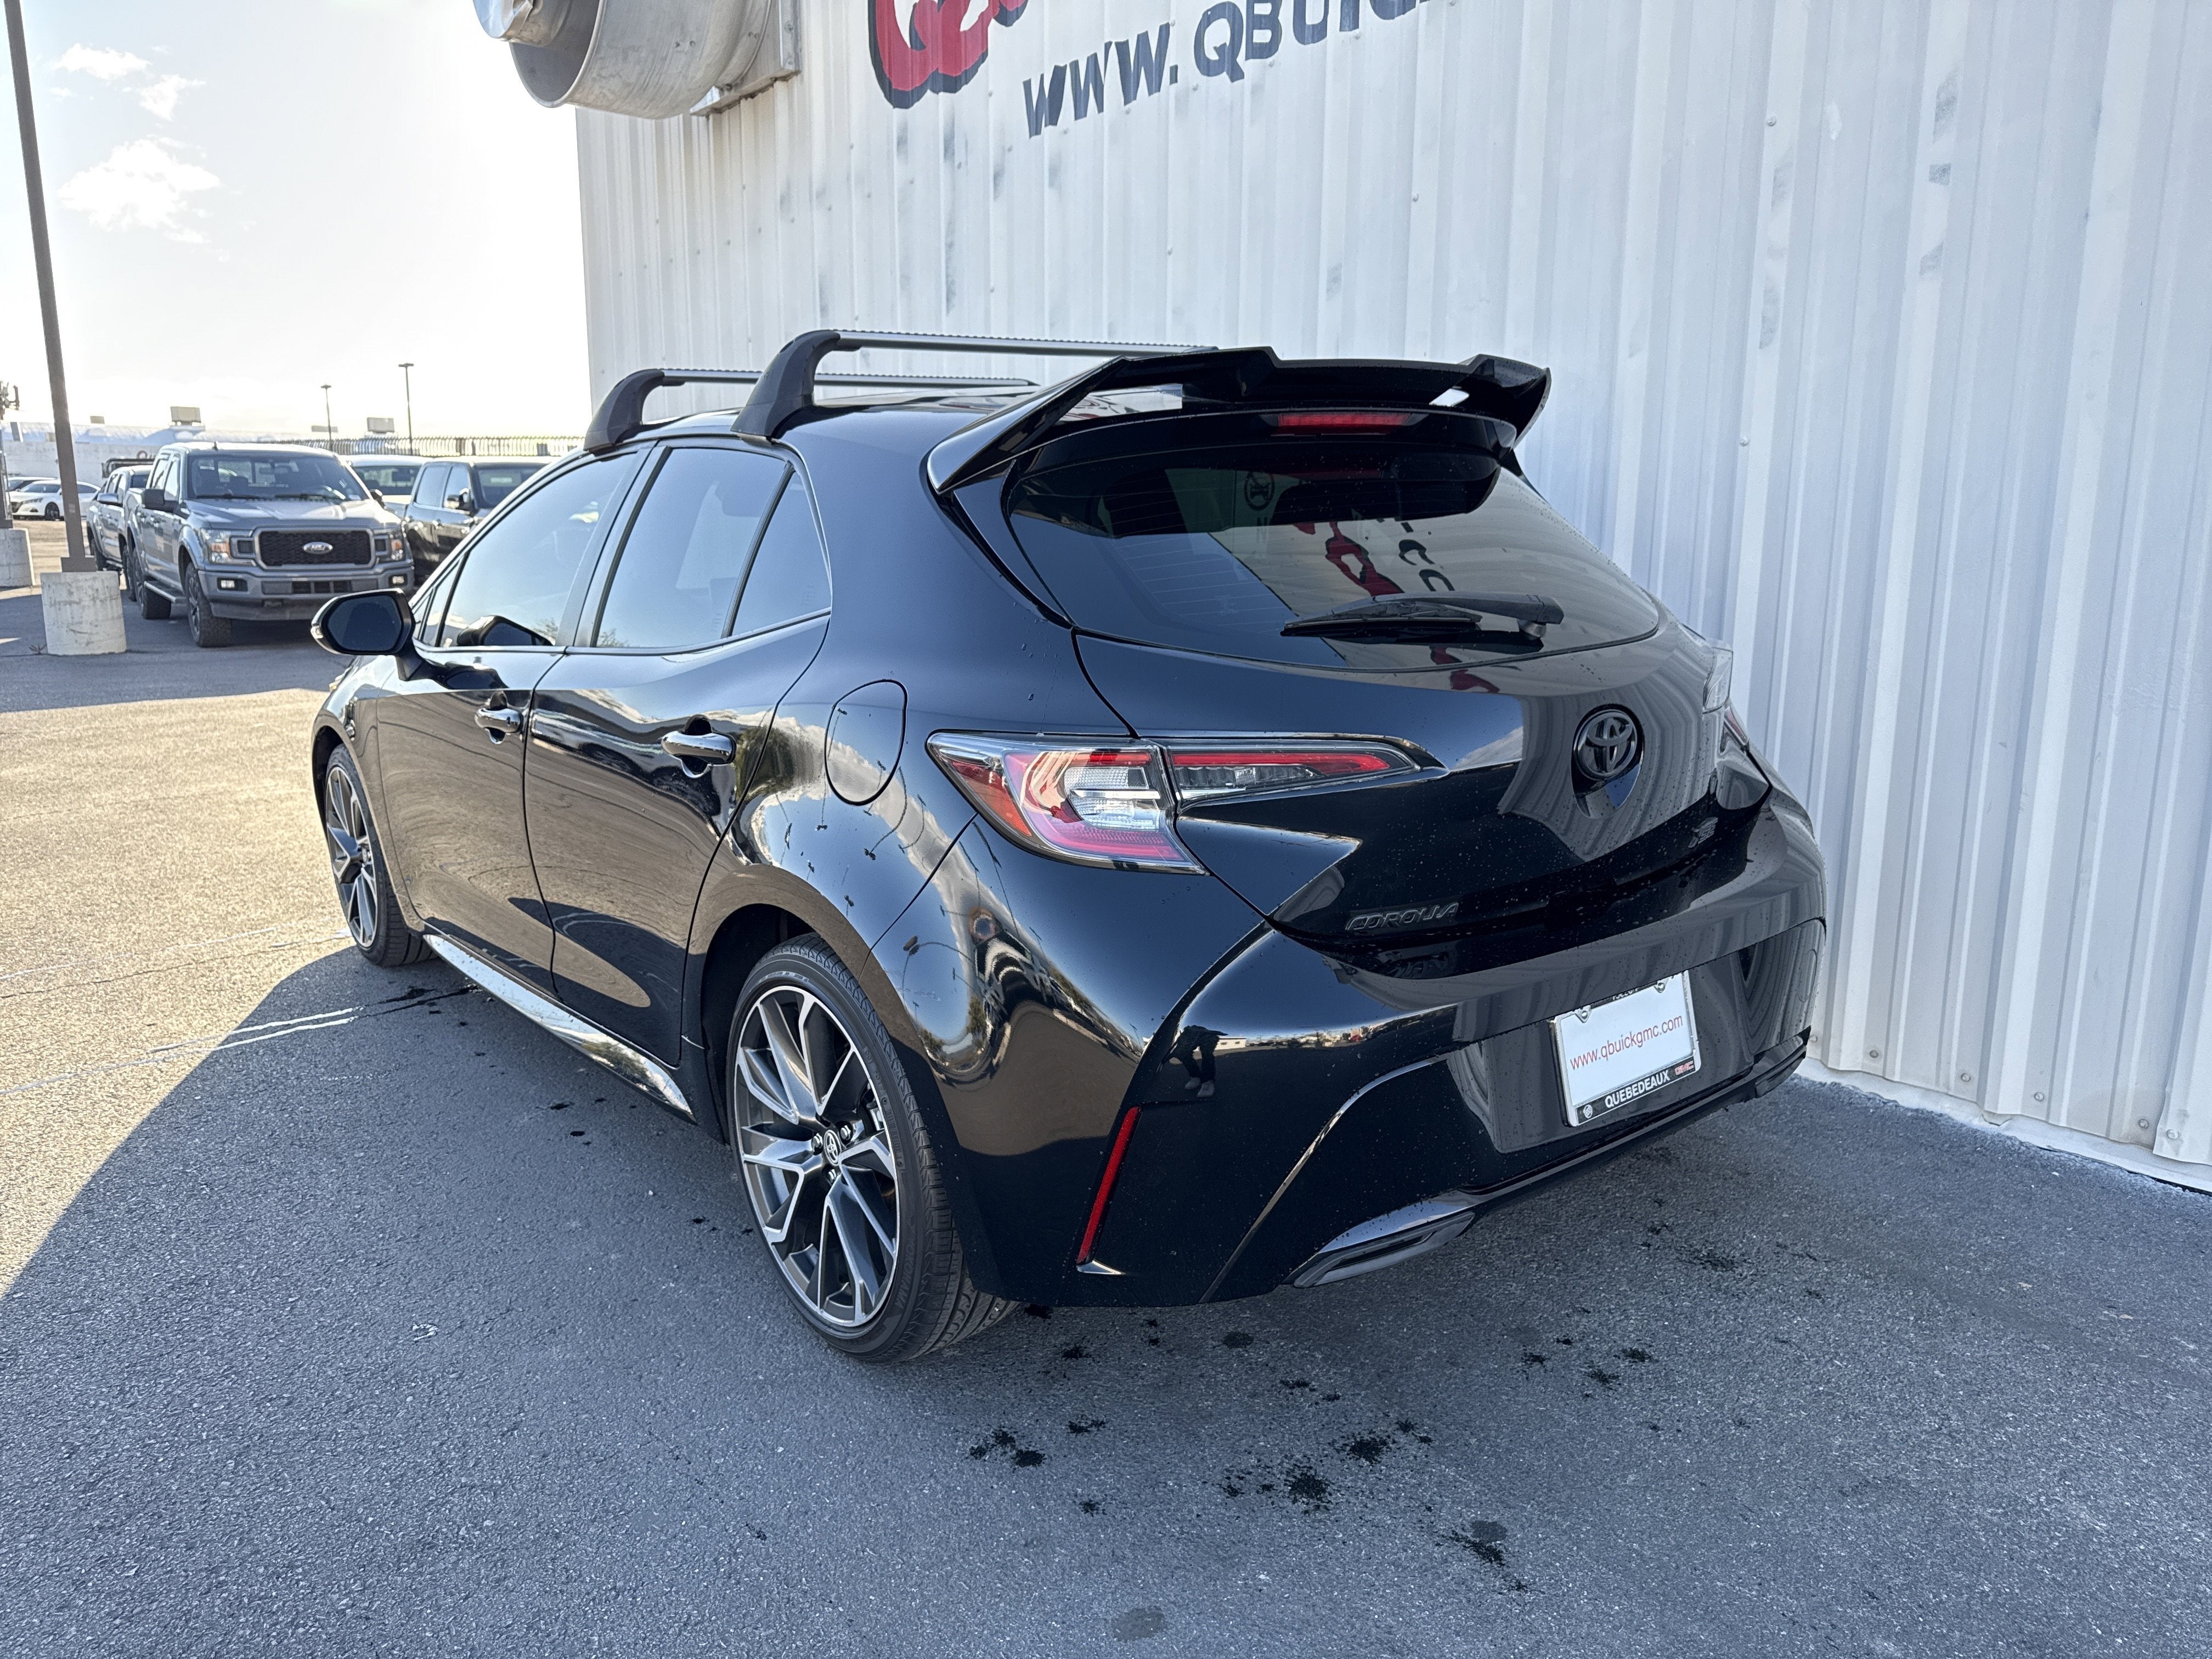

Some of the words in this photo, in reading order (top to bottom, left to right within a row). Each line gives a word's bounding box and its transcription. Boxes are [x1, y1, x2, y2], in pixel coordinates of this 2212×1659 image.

[1570, 1015, 1683, 1070] www.qbuickgmc.com
[1605, 1070, 1671, 1108] QUEBEDEAUX
[1675, 1060, 1695, 1075] GMC
